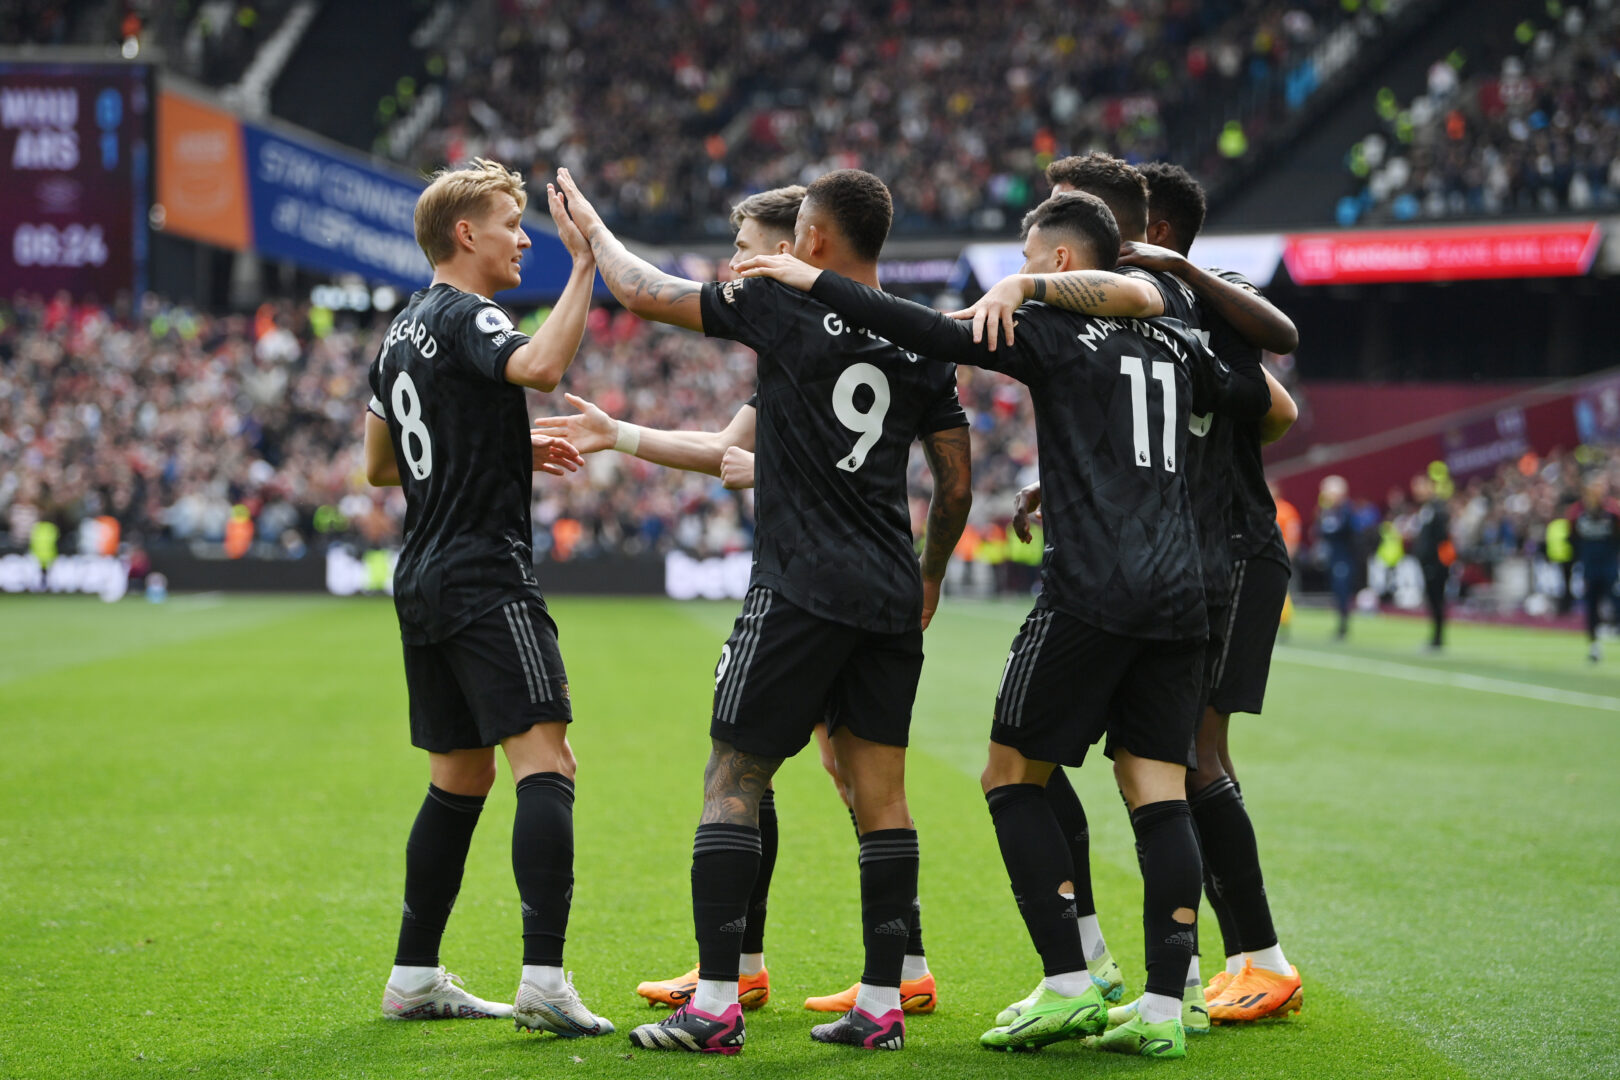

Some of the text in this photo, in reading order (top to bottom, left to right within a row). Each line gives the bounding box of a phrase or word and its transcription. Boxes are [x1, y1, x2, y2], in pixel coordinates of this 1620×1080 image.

[12, 131, 119, 171] ARS 1
[823, 312, 851, 336] G.
[391, 370, 432, 480] 8
[832, 362, 891, 472] 9
[1120, 355, 1176, 472] 11
[714, 643, 731, 691] 9
